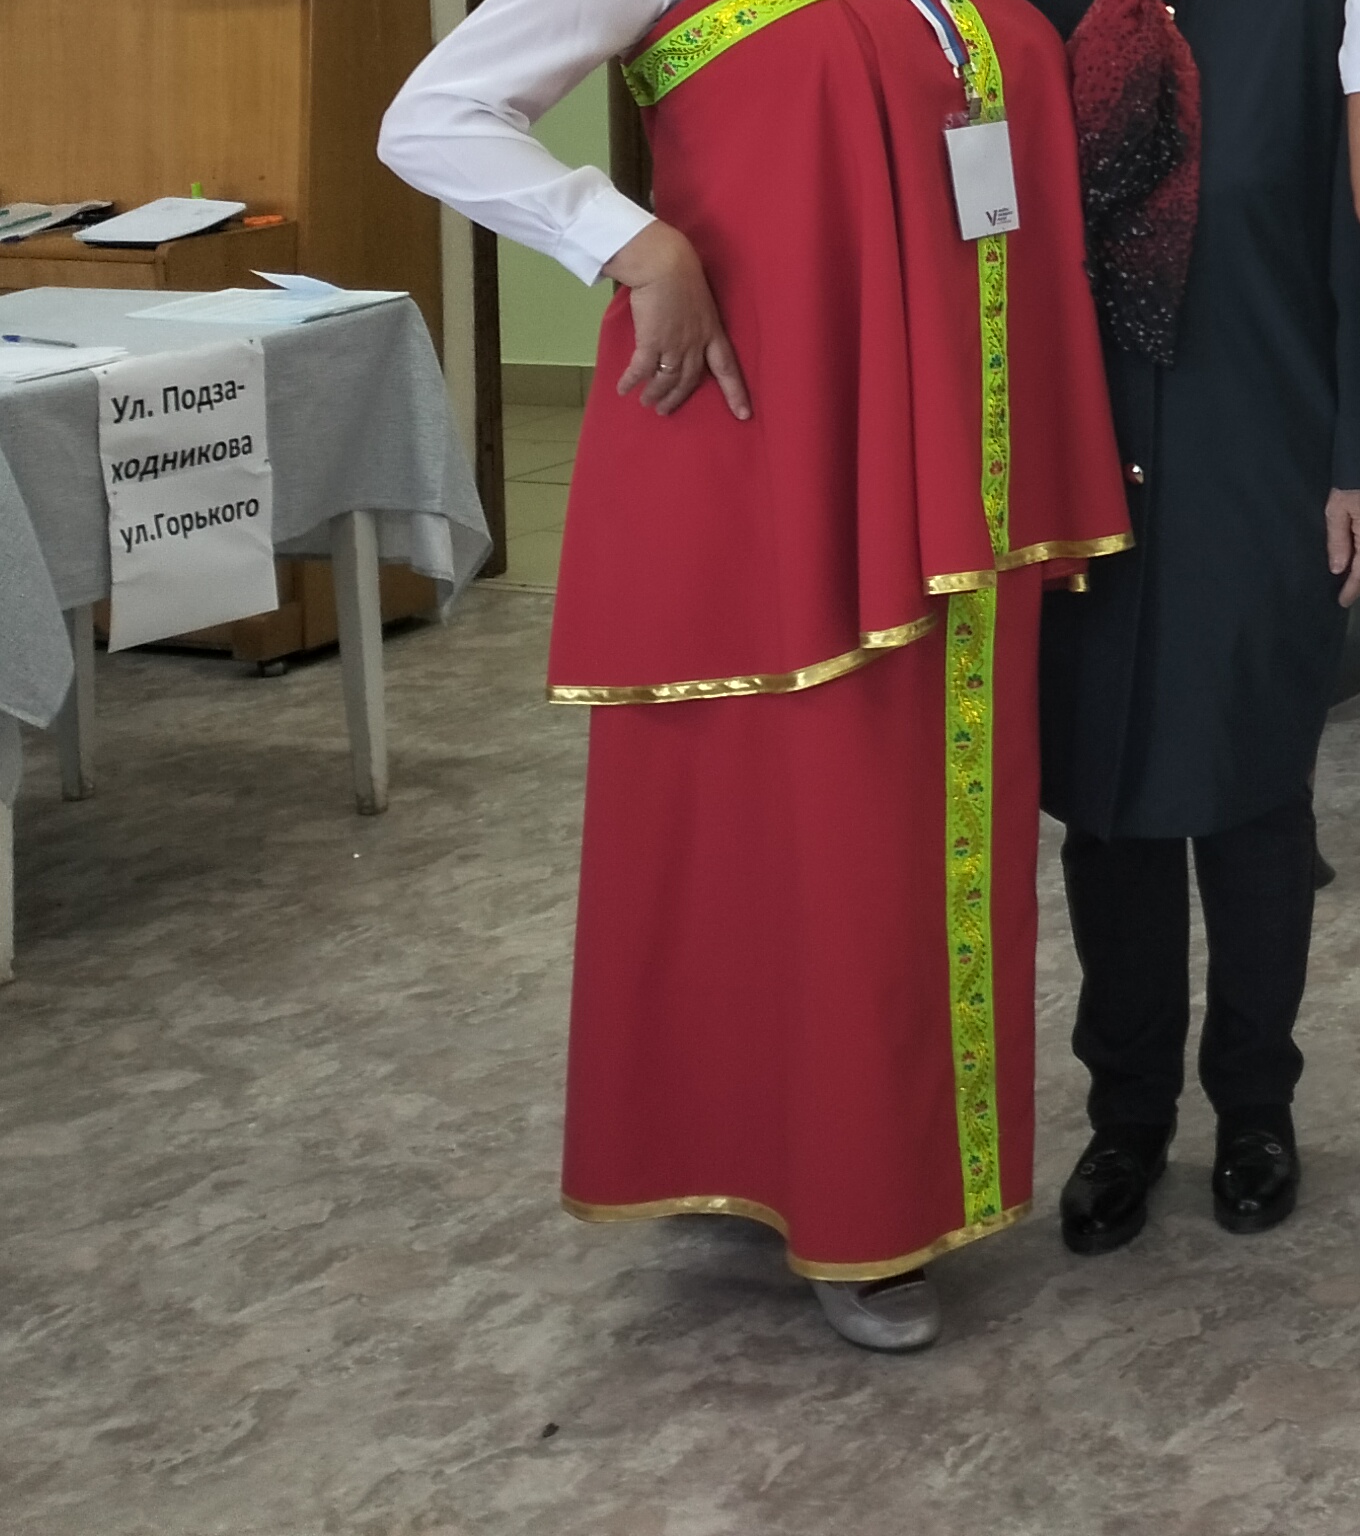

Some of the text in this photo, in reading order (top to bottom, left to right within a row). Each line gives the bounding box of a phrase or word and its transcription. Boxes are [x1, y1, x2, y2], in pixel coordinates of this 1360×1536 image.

[110, 377, 246, 424] Ул. Подза-
[110, 434, 254, 485] ходникова
[120, 496, 260, 553] ул.Горького
